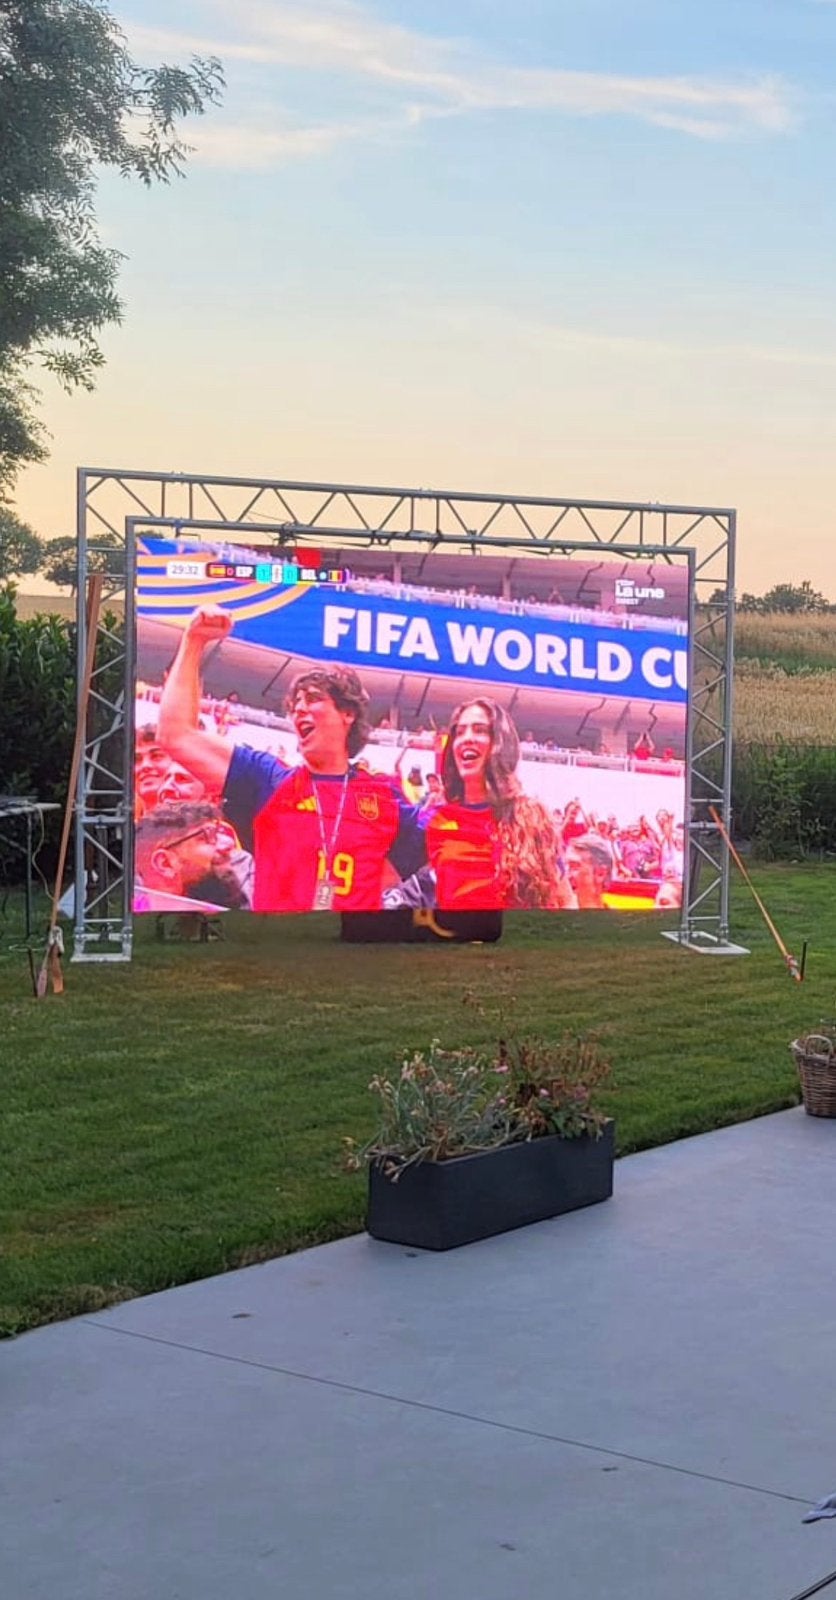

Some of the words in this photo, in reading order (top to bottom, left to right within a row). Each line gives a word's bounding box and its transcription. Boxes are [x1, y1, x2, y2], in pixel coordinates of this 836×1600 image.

[171, 564, 199, 576] 29:32
[634, 587, 665, 600] une
[323, 606, 439, 660] FIFA
[447, 622, 632, 682] WORLD
